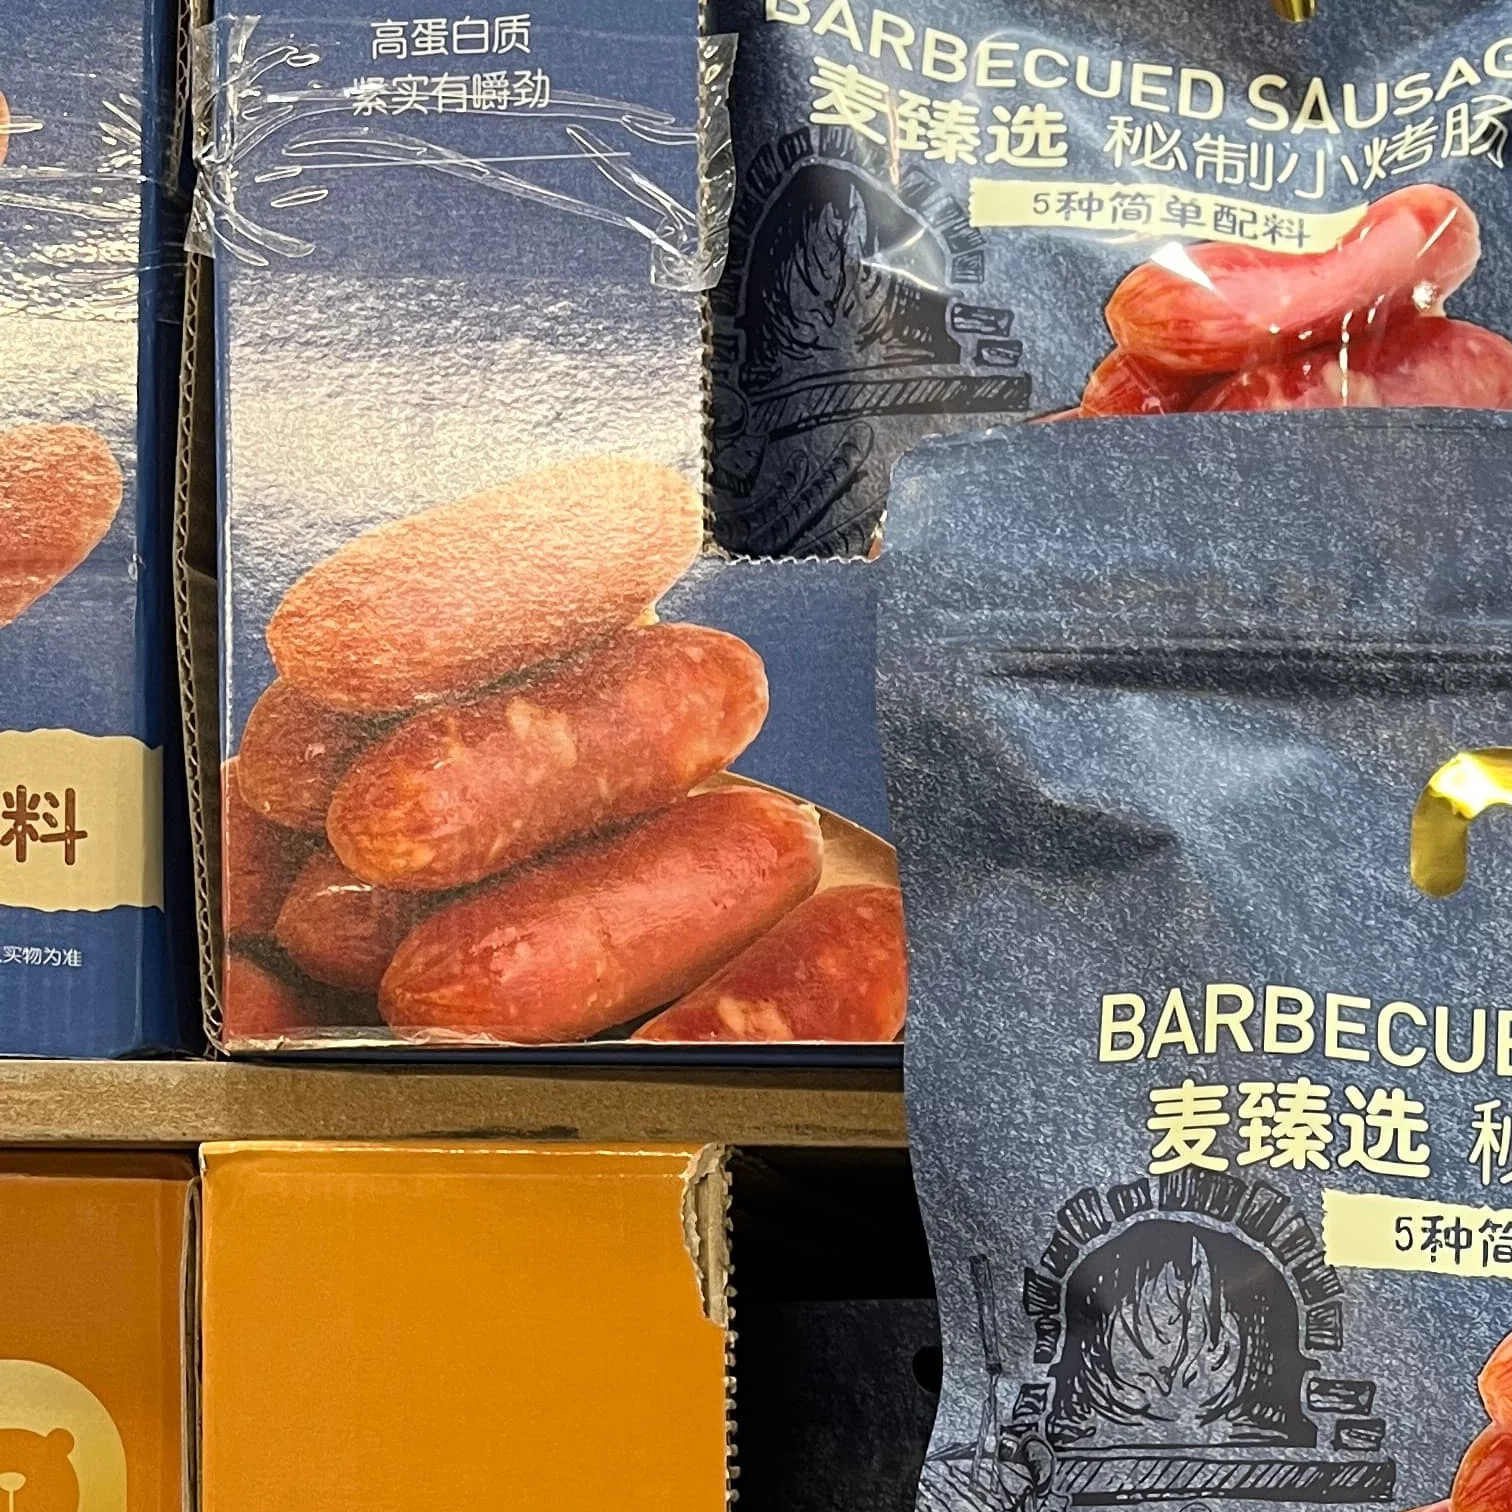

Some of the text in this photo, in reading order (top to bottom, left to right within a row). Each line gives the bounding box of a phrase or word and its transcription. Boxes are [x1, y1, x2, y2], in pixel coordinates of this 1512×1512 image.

[370, 13, 531, 59] 高蛋白质
[765, 0, 1224, 121] BARBECUED
[352, 68, 550, 116] 紧实有嚼劲
[809, 55, 1068, 168] 麦臻选
[1032, 191, 1310, 248] 5种简单配料
[0, 784, 88, 866] 料
[0, 945, 82, 967] 实物为准
[1145, 1079, 1432, 1181] 麦臻选
